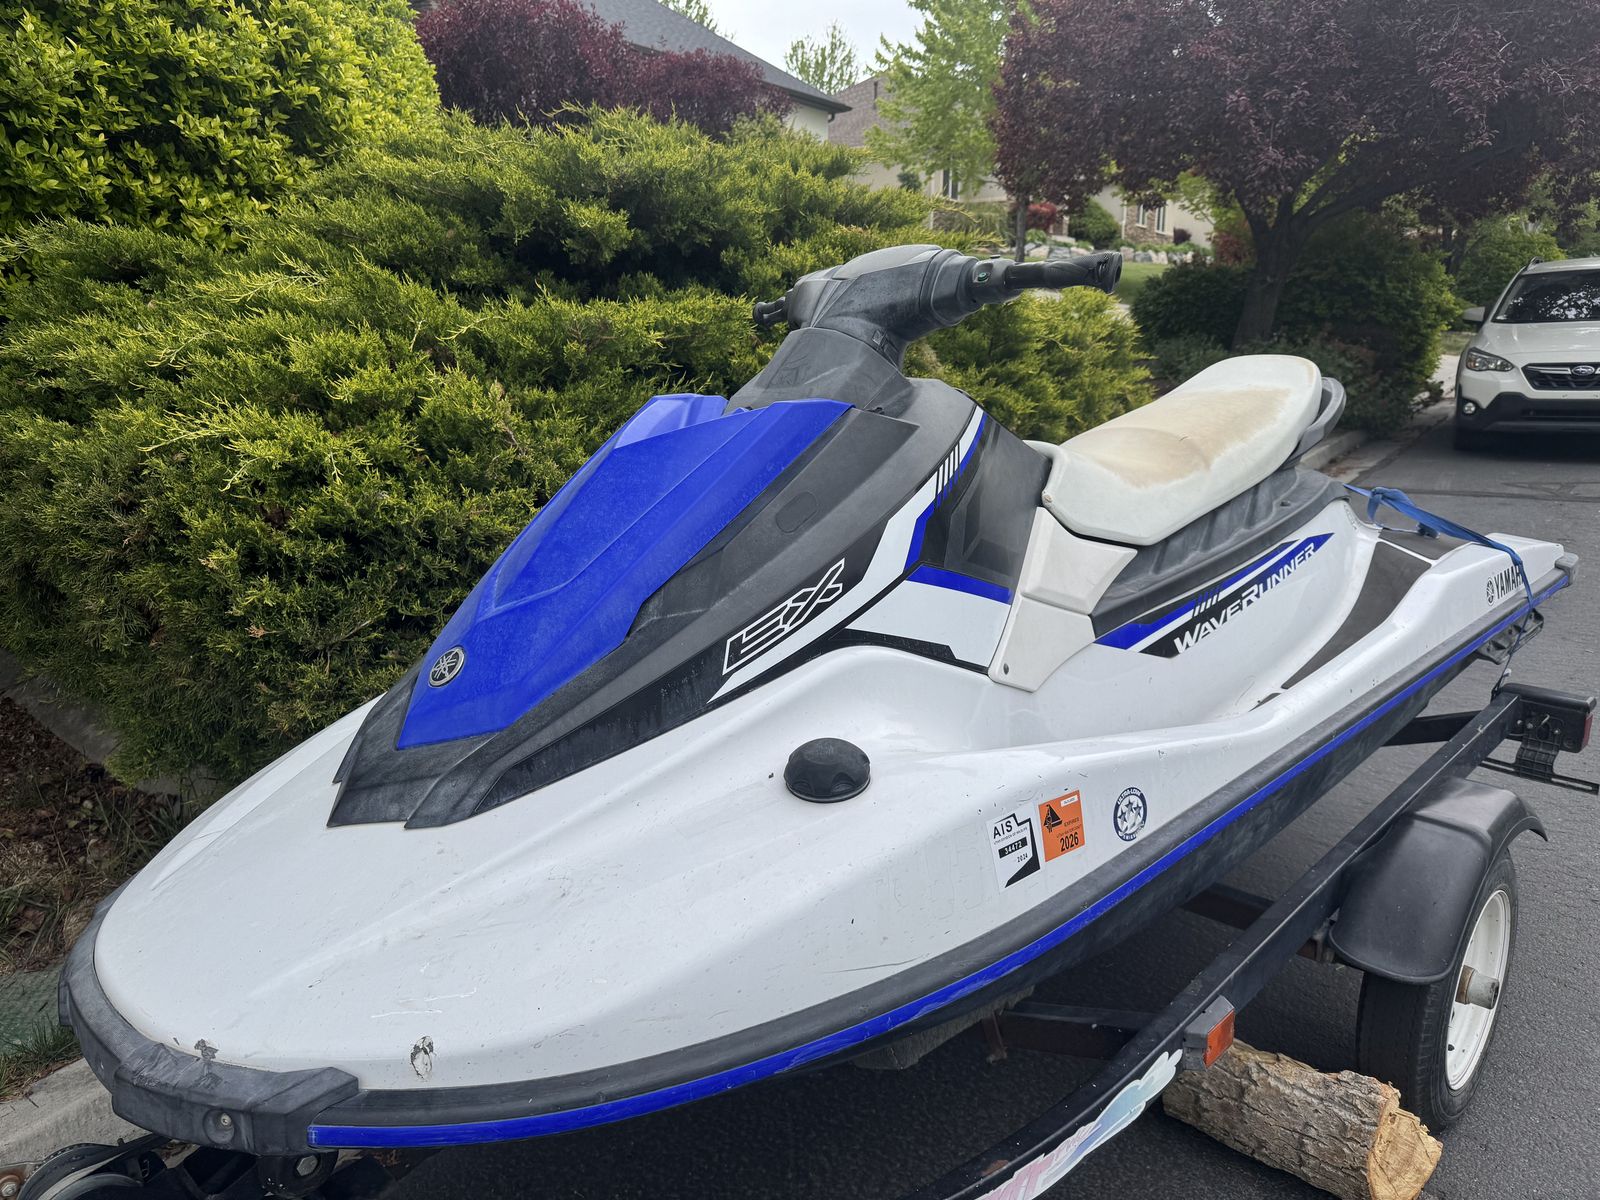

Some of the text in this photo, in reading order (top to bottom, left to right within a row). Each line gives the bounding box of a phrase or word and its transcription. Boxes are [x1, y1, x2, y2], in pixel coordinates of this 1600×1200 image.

[1174, 542, 1315, 655] WAVERUNNER
[1494, 566, 1524, 600] YAMAH
[722, 557, 846, 676] EX
[993, 820, 1013, 839] AIS
[1060, 831, 1079, 852] 2026
